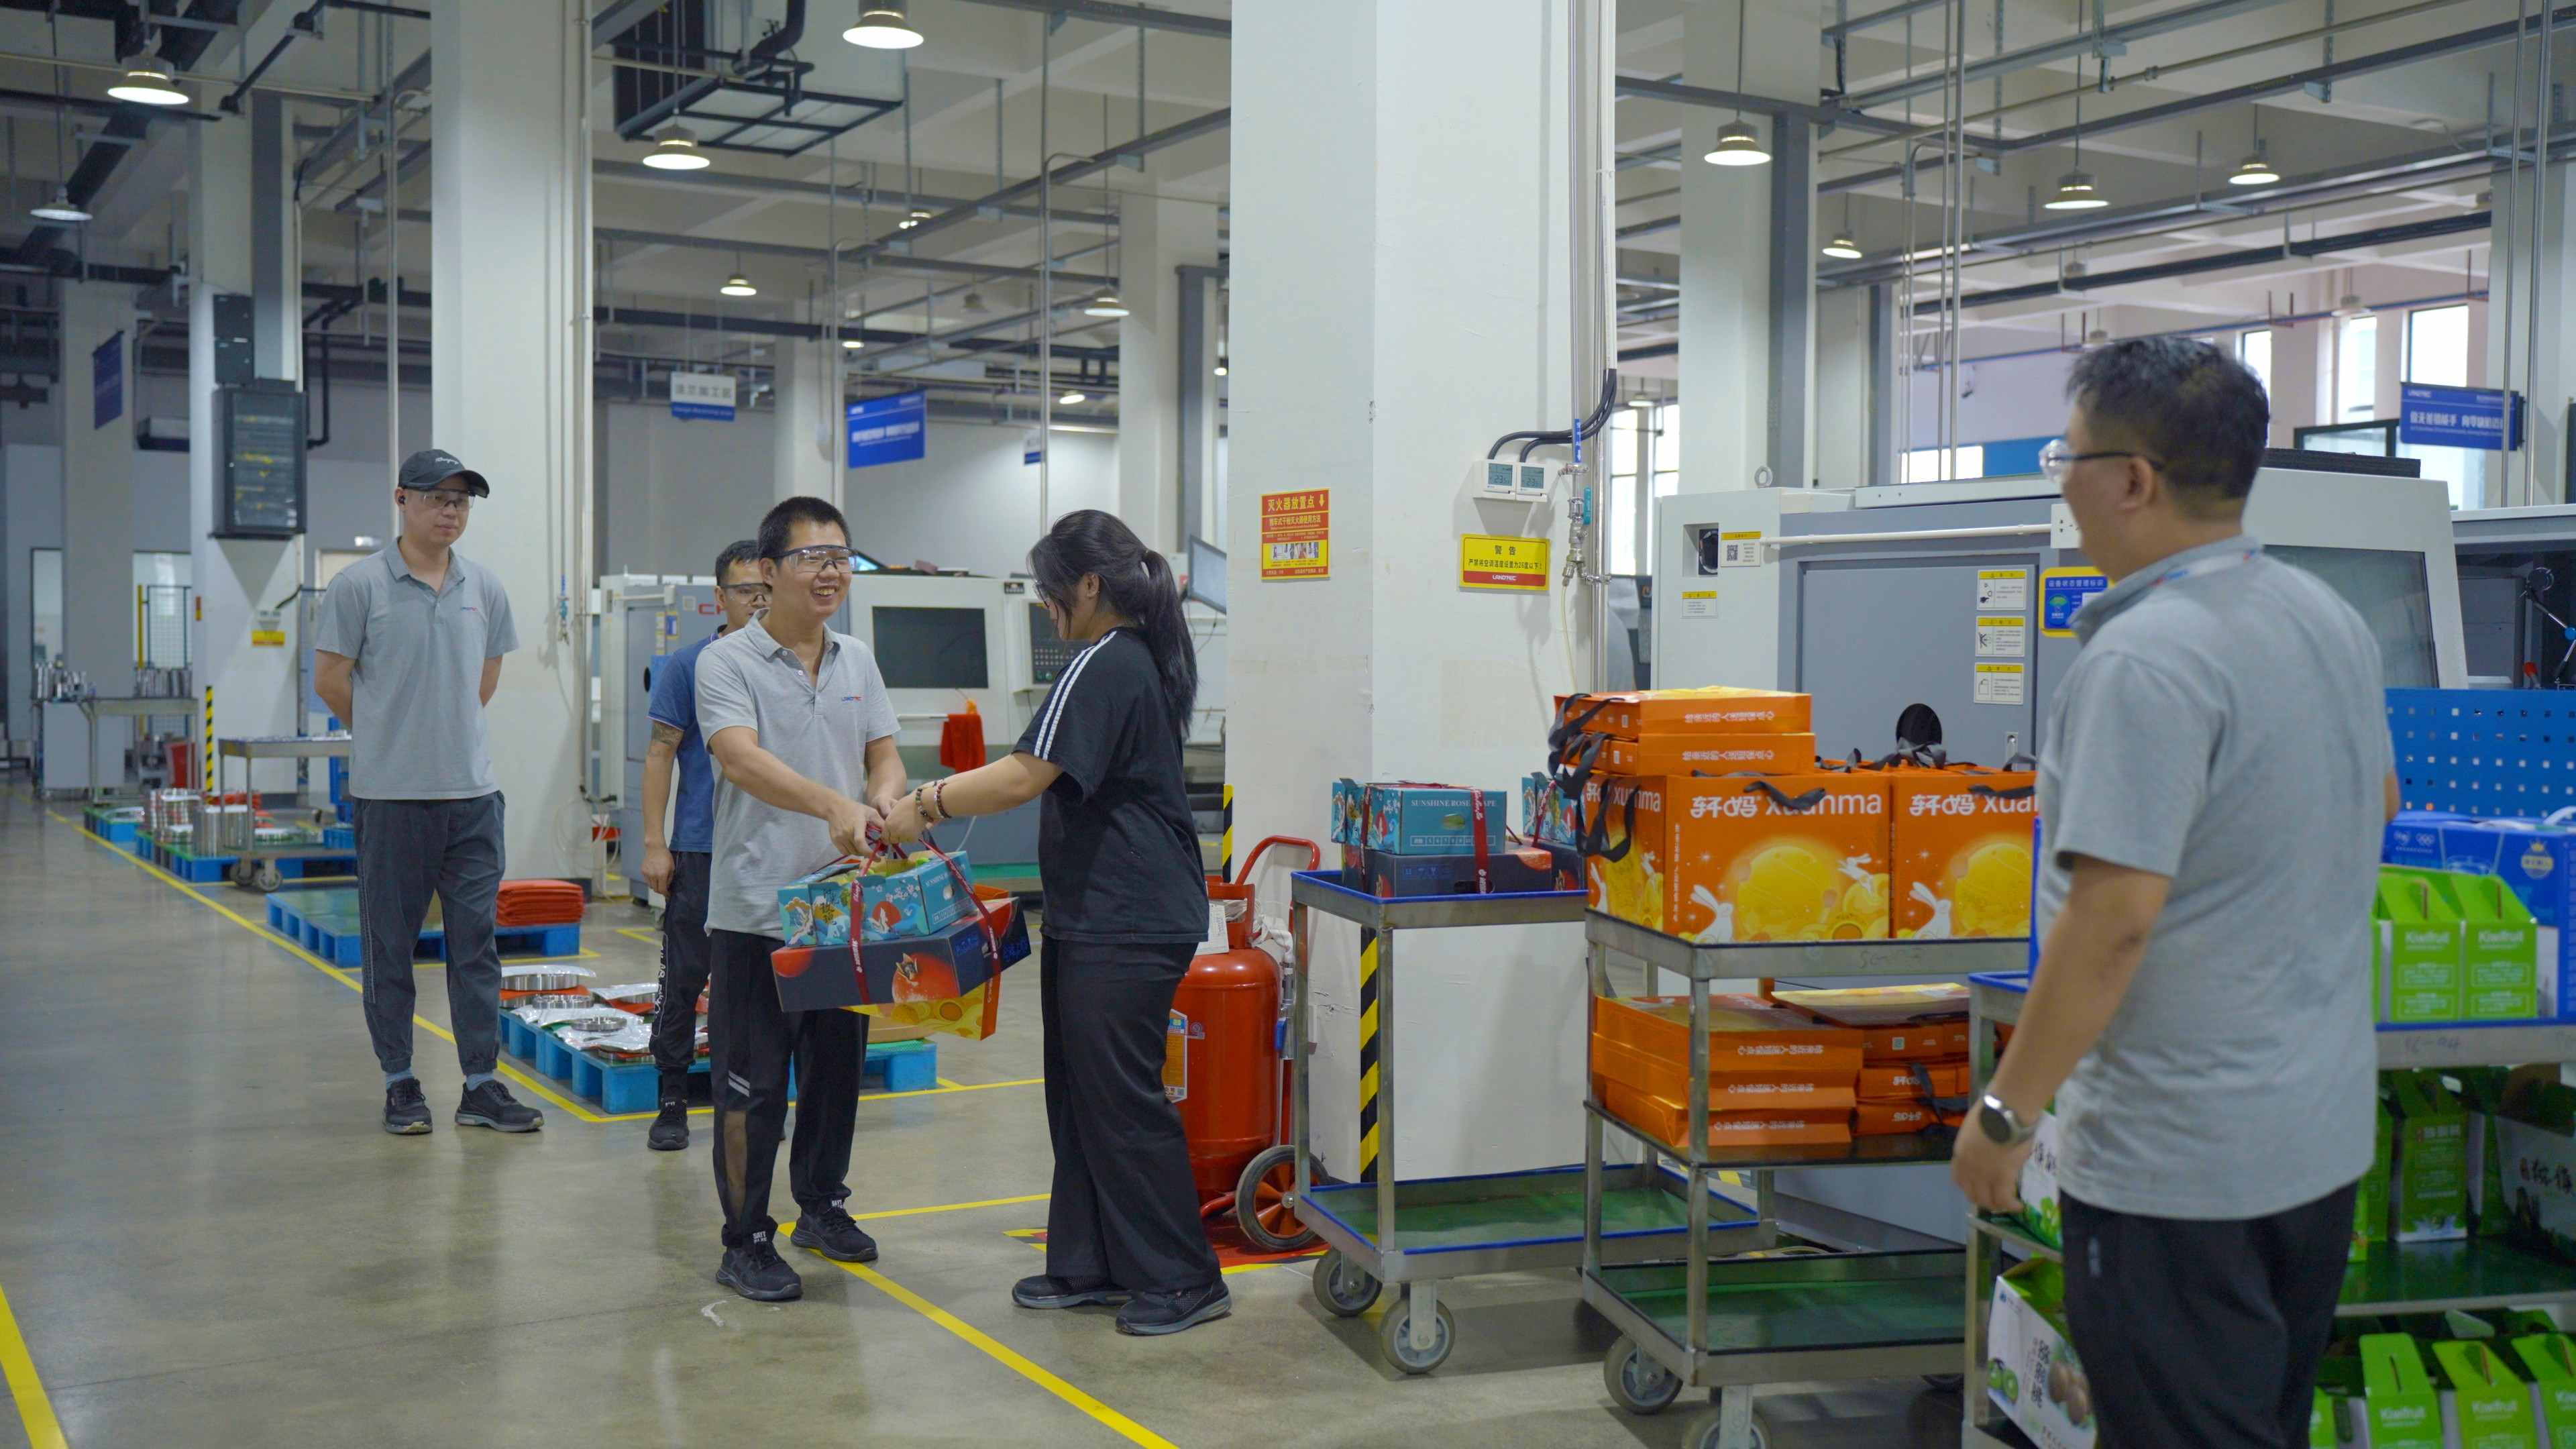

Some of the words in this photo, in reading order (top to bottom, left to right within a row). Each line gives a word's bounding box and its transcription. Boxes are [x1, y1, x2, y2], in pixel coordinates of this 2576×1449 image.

[1267, 494, 1315, 512] 灭火器放置点
[1411, 799, 1450, 807] SUNSHINE
[1451, 799, 1471, 807] ROSE
